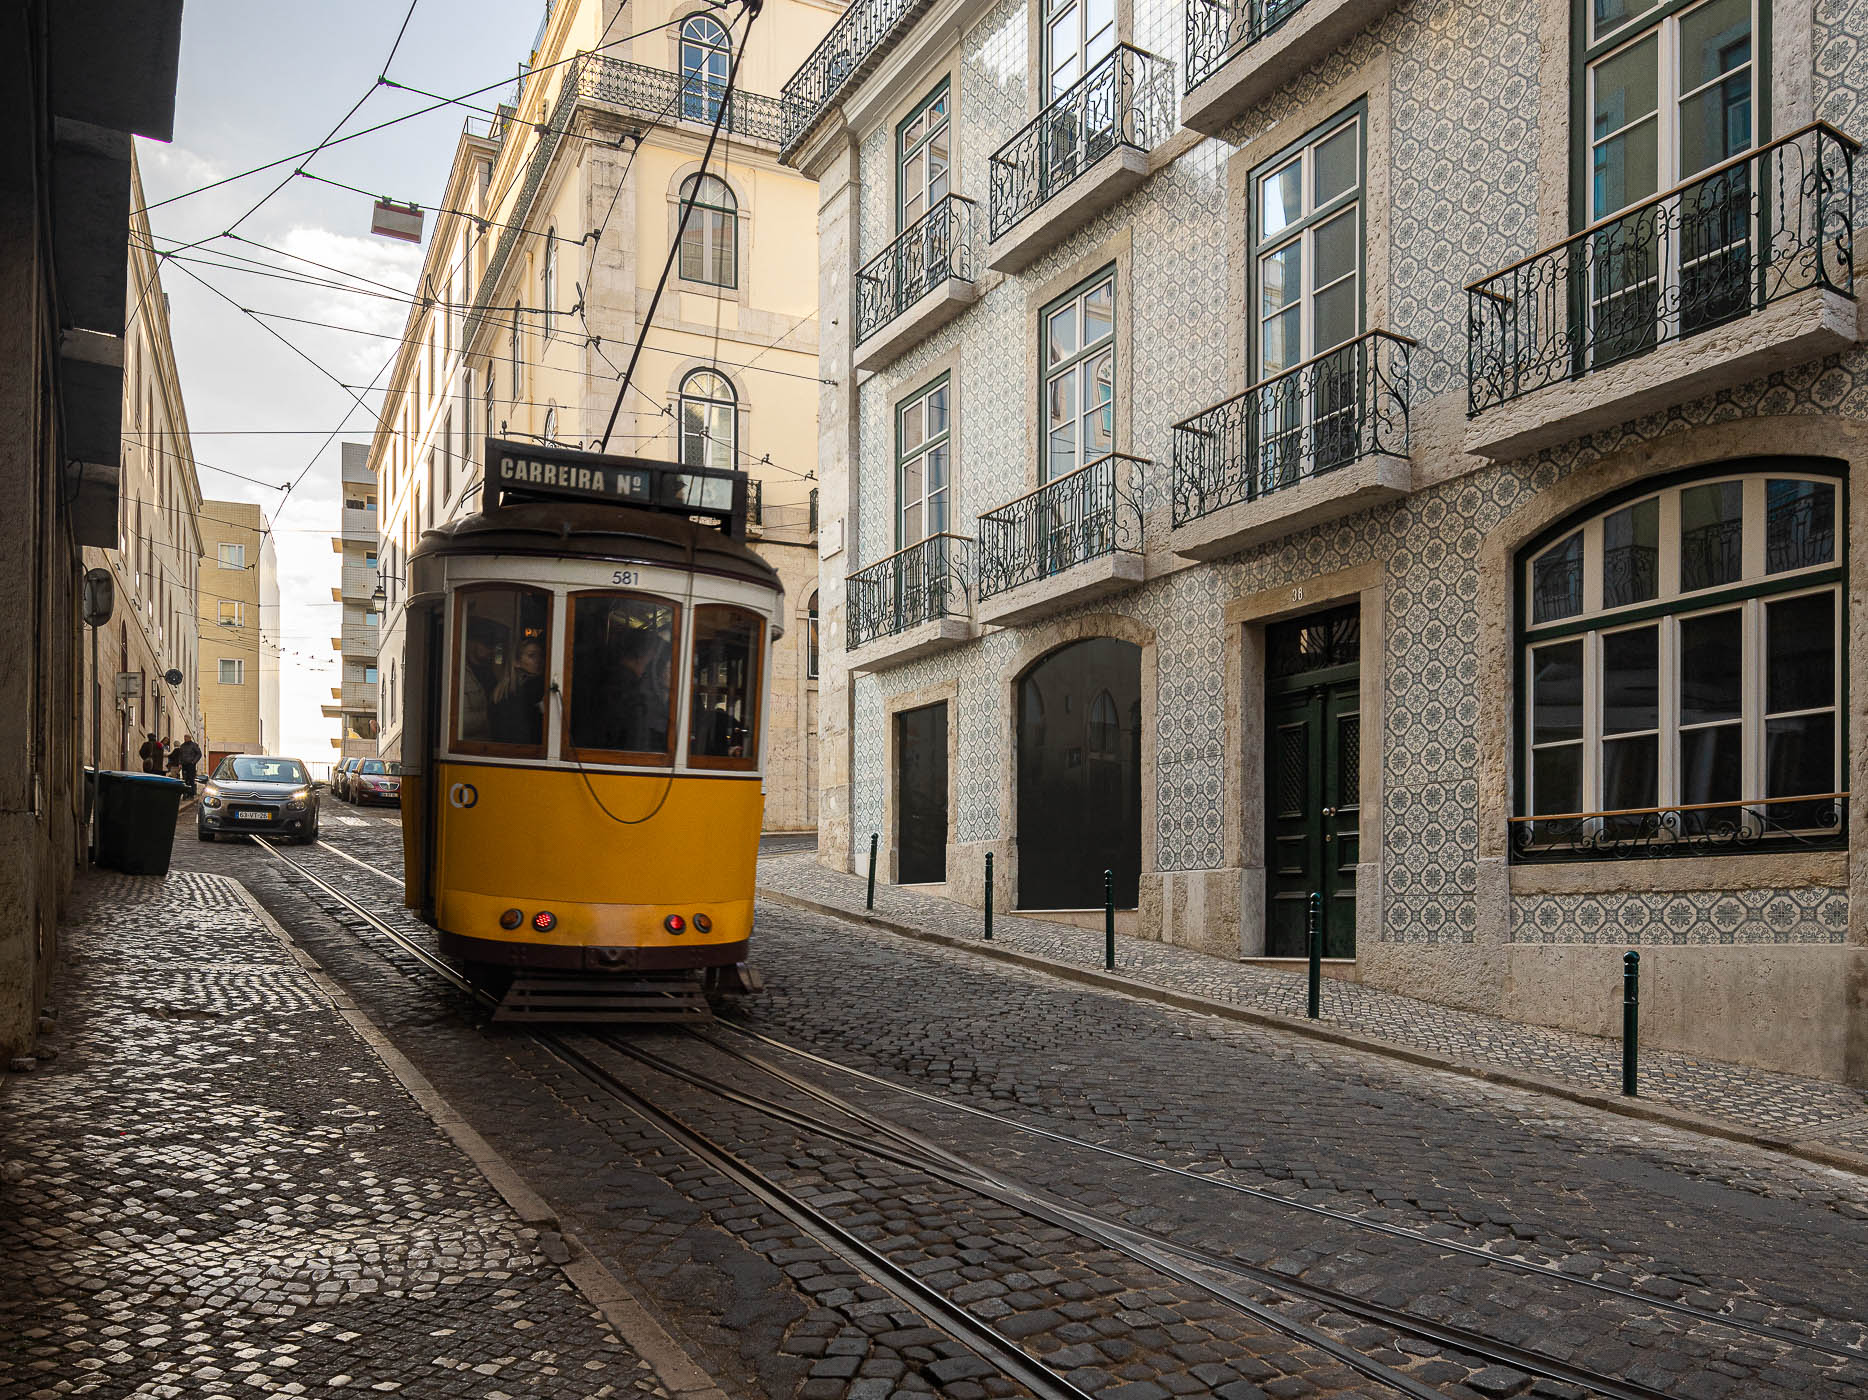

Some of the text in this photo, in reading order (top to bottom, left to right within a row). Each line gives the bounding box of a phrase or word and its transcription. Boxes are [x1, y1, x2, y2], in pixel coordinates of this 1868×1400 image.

[501, 458, 604, 491] CARREIRA
[612, 571, 638, 585] 581
[1292, 586, 1303, 602] 38
